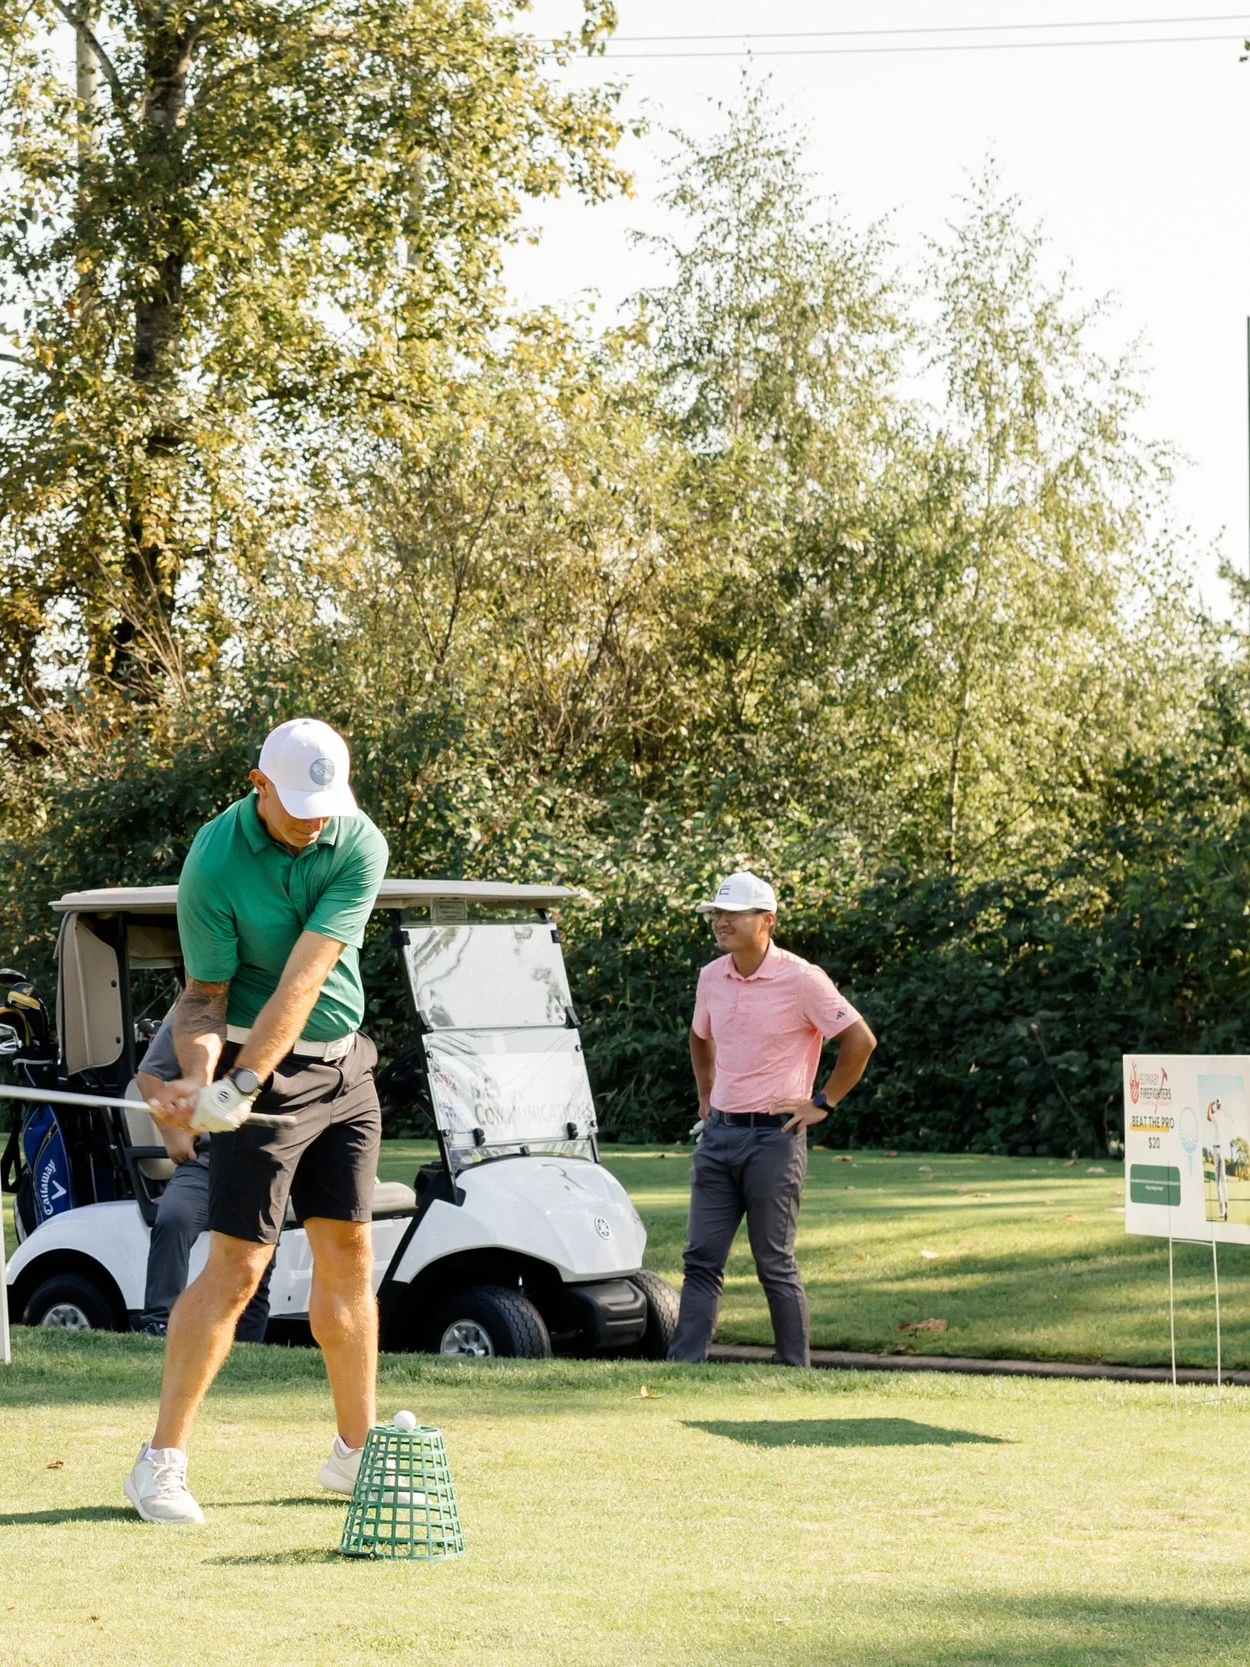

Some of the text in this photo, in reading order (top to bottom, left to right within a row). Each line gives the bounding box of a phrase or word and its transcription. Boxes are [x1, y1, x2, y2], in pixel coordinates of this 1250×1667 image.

[1132, 1115, 1175, 1130] BEAT THE PRO
[40, 1160, 56, 1215] Callaway
